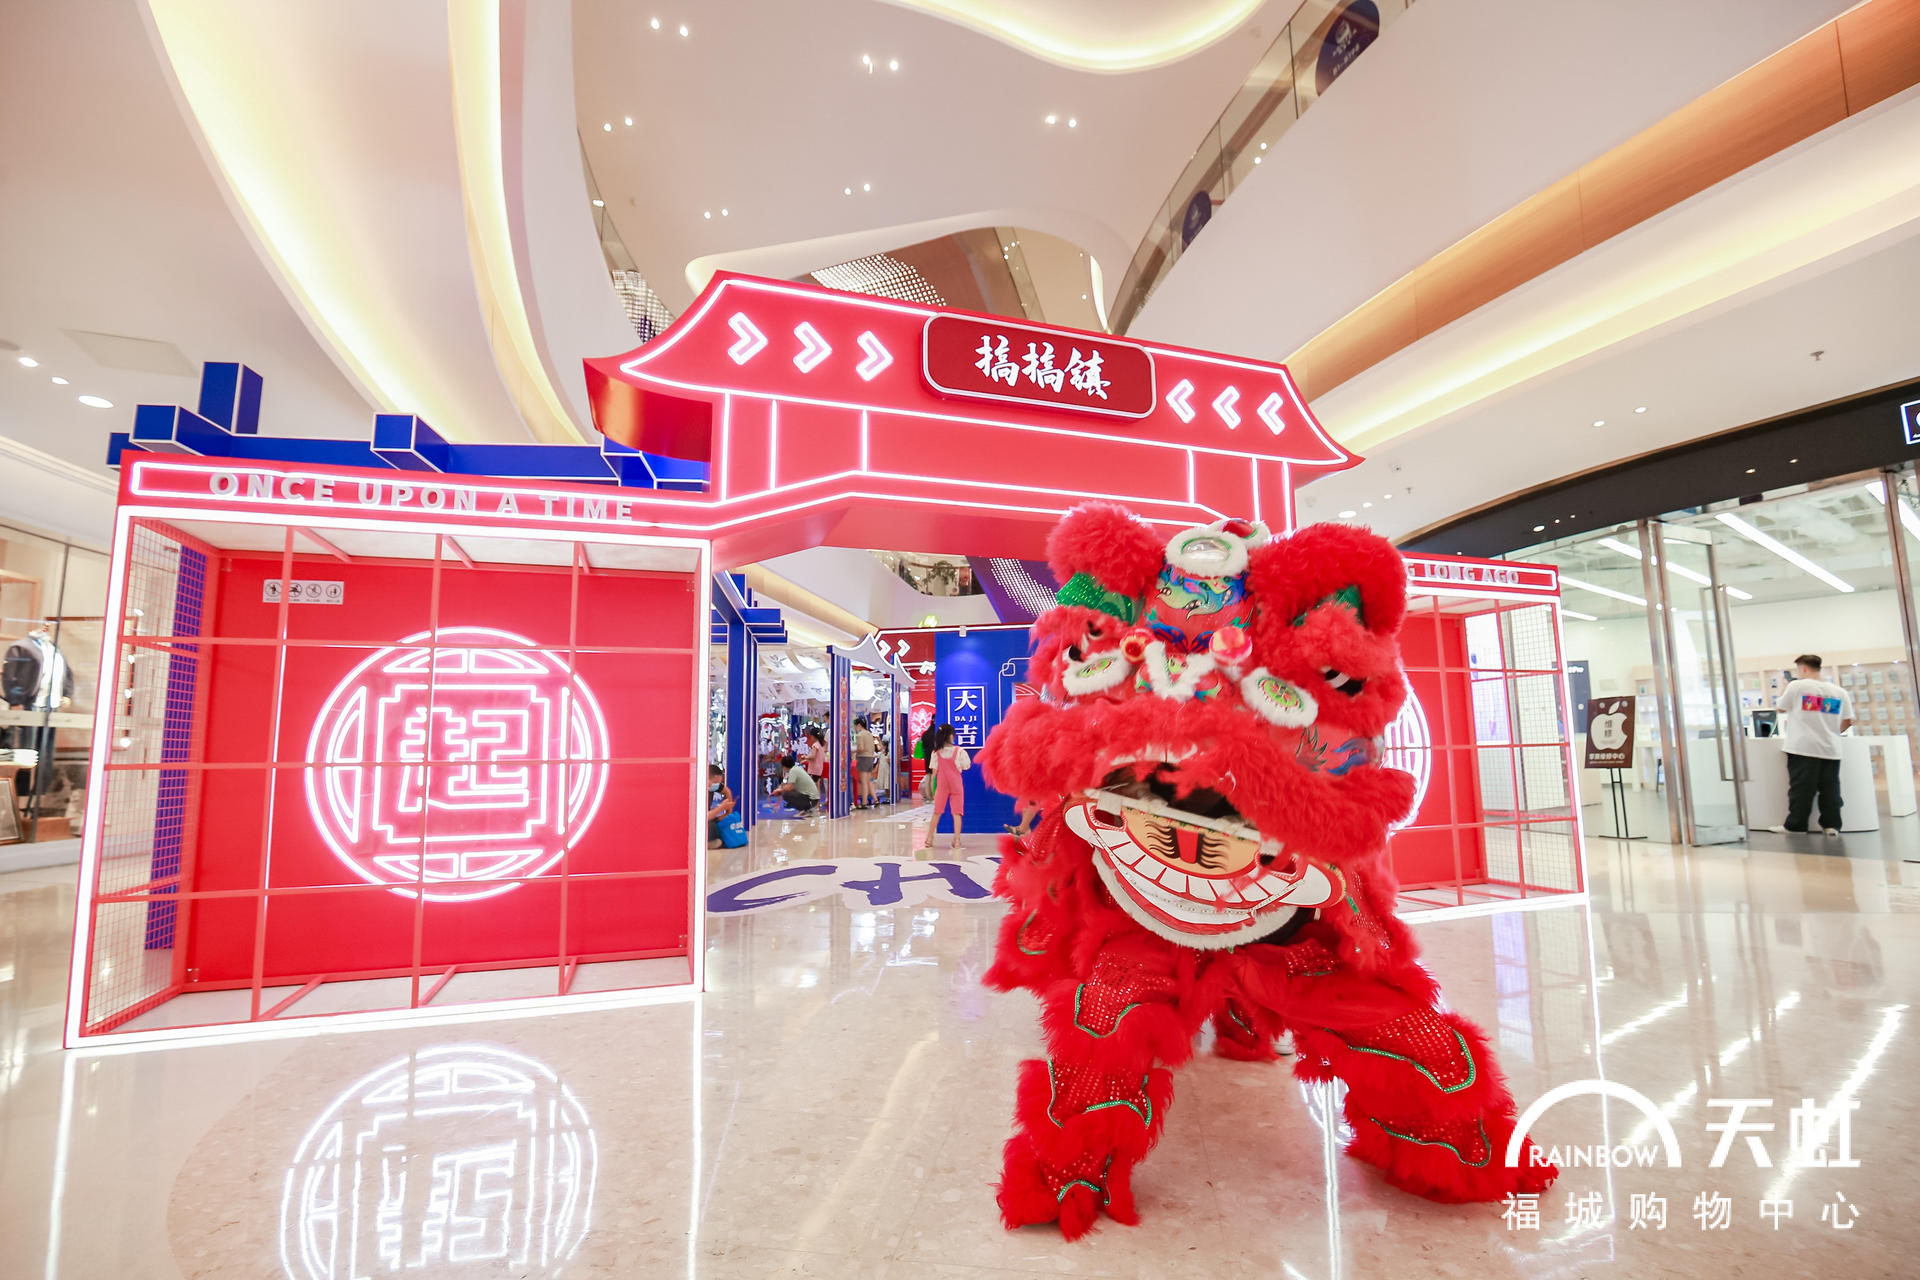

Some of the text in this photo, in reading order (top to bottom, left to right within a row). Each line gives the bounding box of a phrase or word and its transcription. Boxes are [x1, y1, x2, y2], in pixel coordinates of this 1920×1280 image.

[209, 471, 634, 522] ONCE UPON A TIME
[1424, 562, 1476, 582] LONG
[1482, 566, 1520, 585] AGO
[968, 715, 977, 723] JI
[706, 856, 1003, 913] CH
